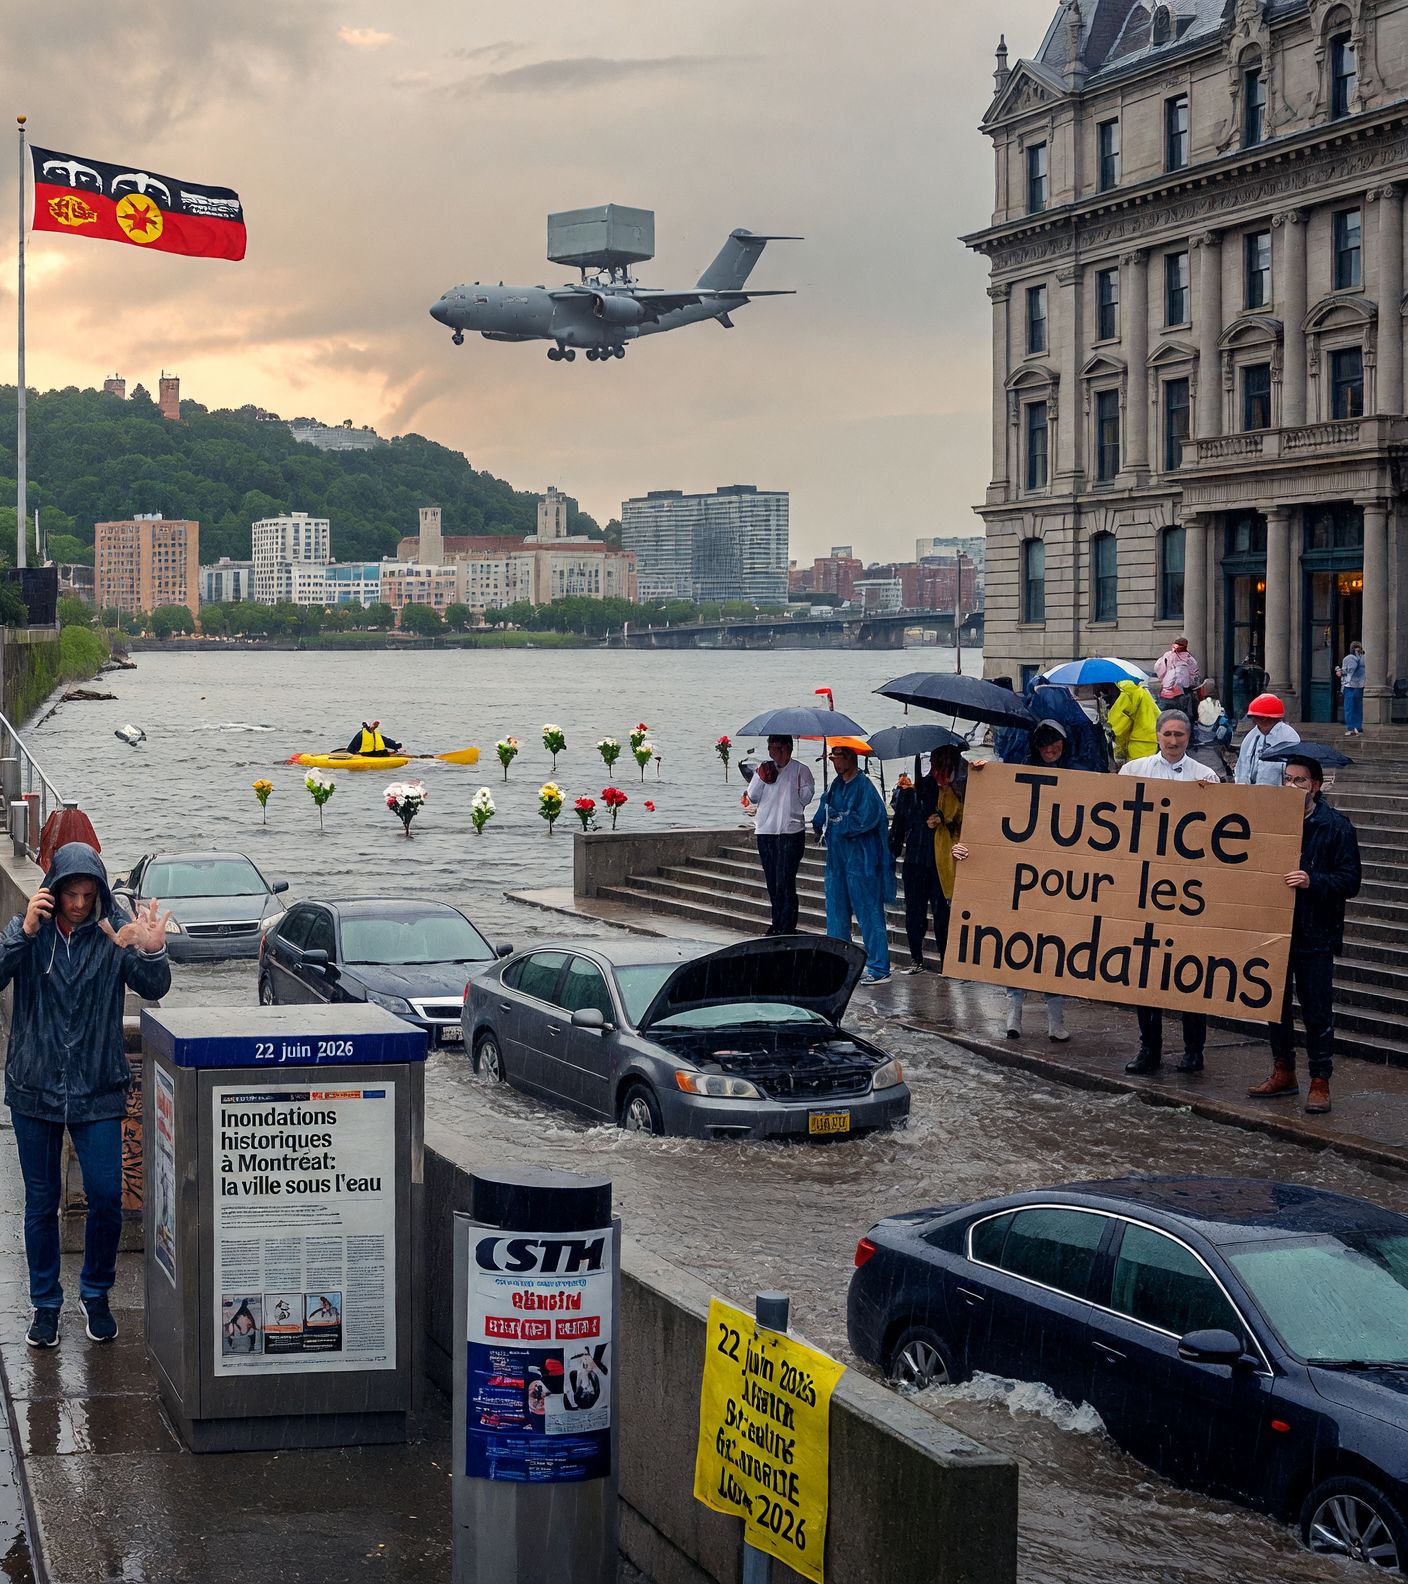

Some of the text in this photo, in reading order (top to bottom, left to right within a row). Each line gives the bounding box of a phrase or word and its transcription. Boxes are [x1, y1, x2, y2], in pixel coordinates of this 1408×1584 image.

[1001, 773, 1251, 864] Justice
[1011, 859, 1206, 916] pour les
[958, 910, 1274, 1009] inondations
[255, 1041, 354, 1062] 22 juin 2026
[221, 1107, 337, 1128] Inondations
[221, 1131, 332, 1153] historiques
[221, 1155, 233, 1173] à
[222, 1174, 382, 1196] la ville sous l'eau
[717, 1322, 741, 1363] 22
[741, 1338, 775, 1383] juin
[755, 1494, 807, 1551] 2026
